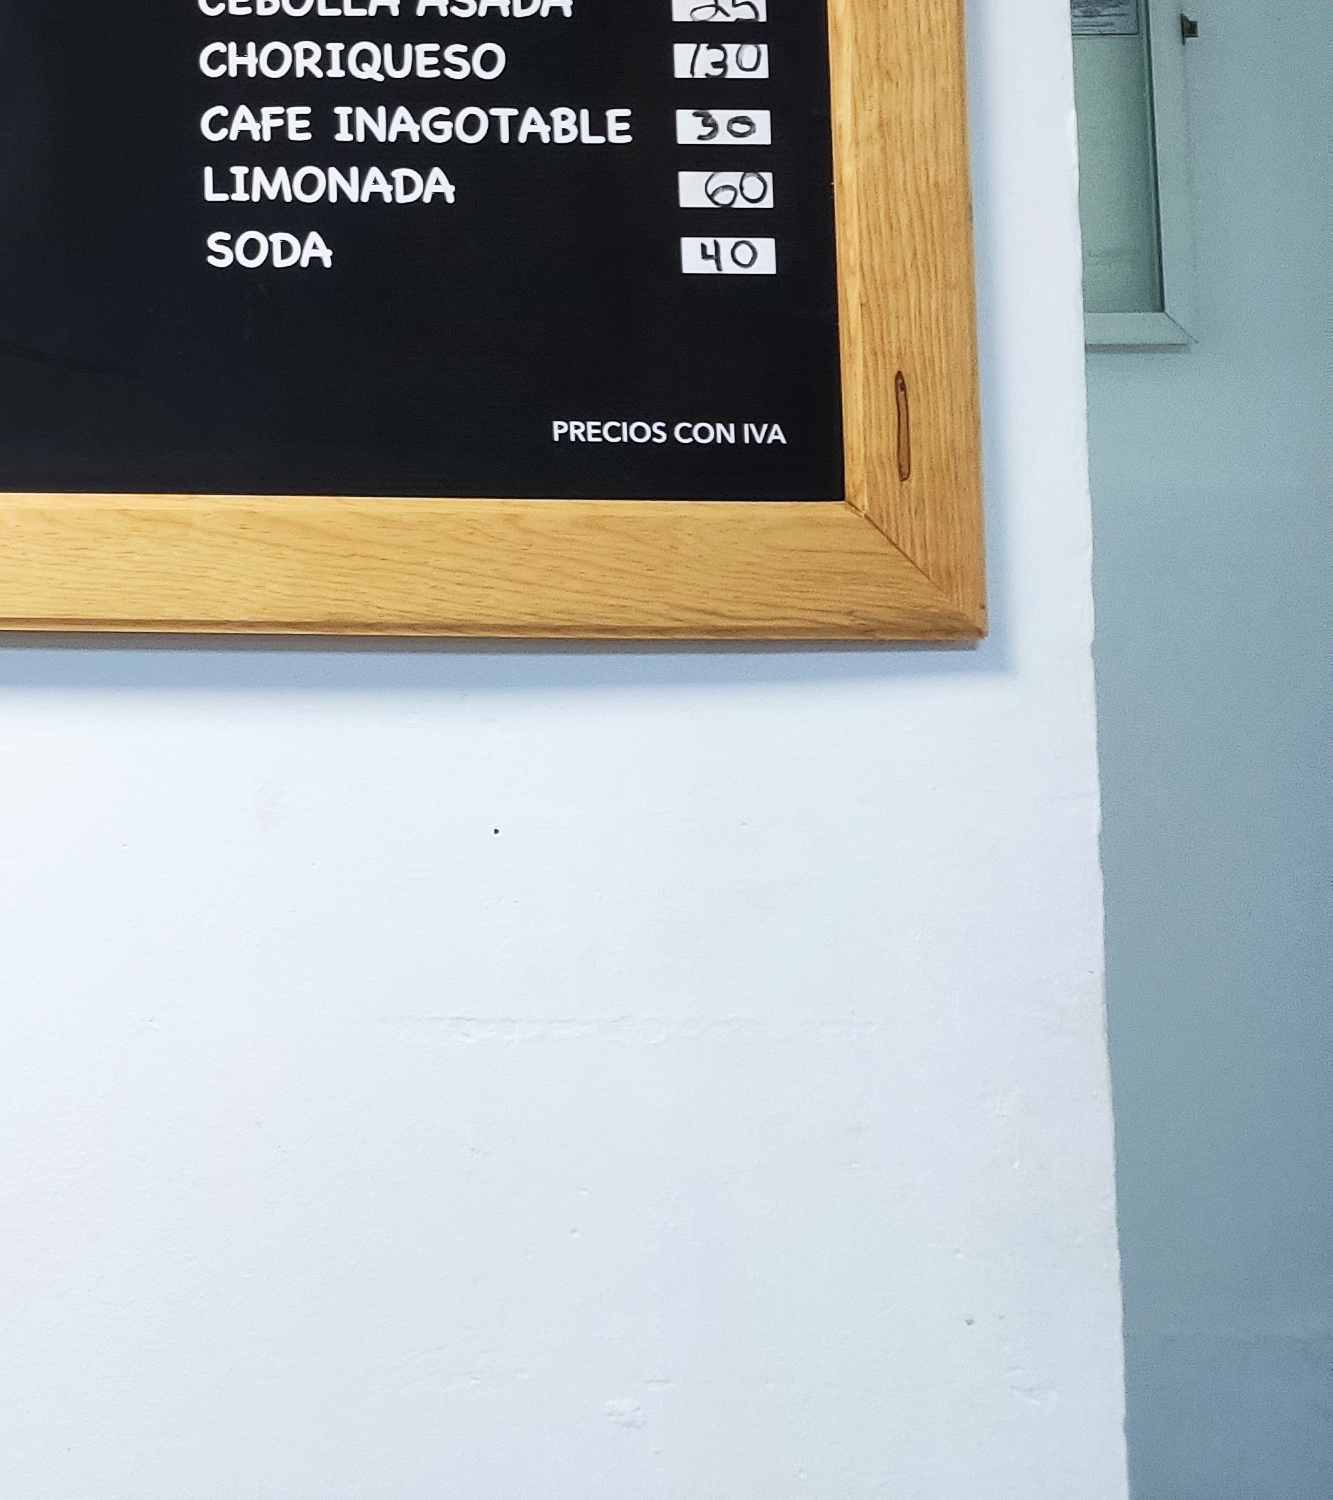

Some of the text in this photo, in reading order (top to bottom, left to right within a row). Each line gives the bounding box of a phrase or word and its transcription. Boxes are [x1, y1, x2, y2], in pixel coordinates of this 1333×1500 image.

[199, 41, 505, 81] CHORIQUESO
[690, 43, 761, 78] 130
[201, 105, 632, 143] CAFE INAGOTABLE
[692, 111, 756, 140] 30
[204, 166, 455, 203] LIMONADA
[704, 171, 767, 208] 60
[207, 231, 332, 268] SODA
[700, 239, 758, 271] 40
[553, 421, 786, 443] PRECIOS CON IVA
